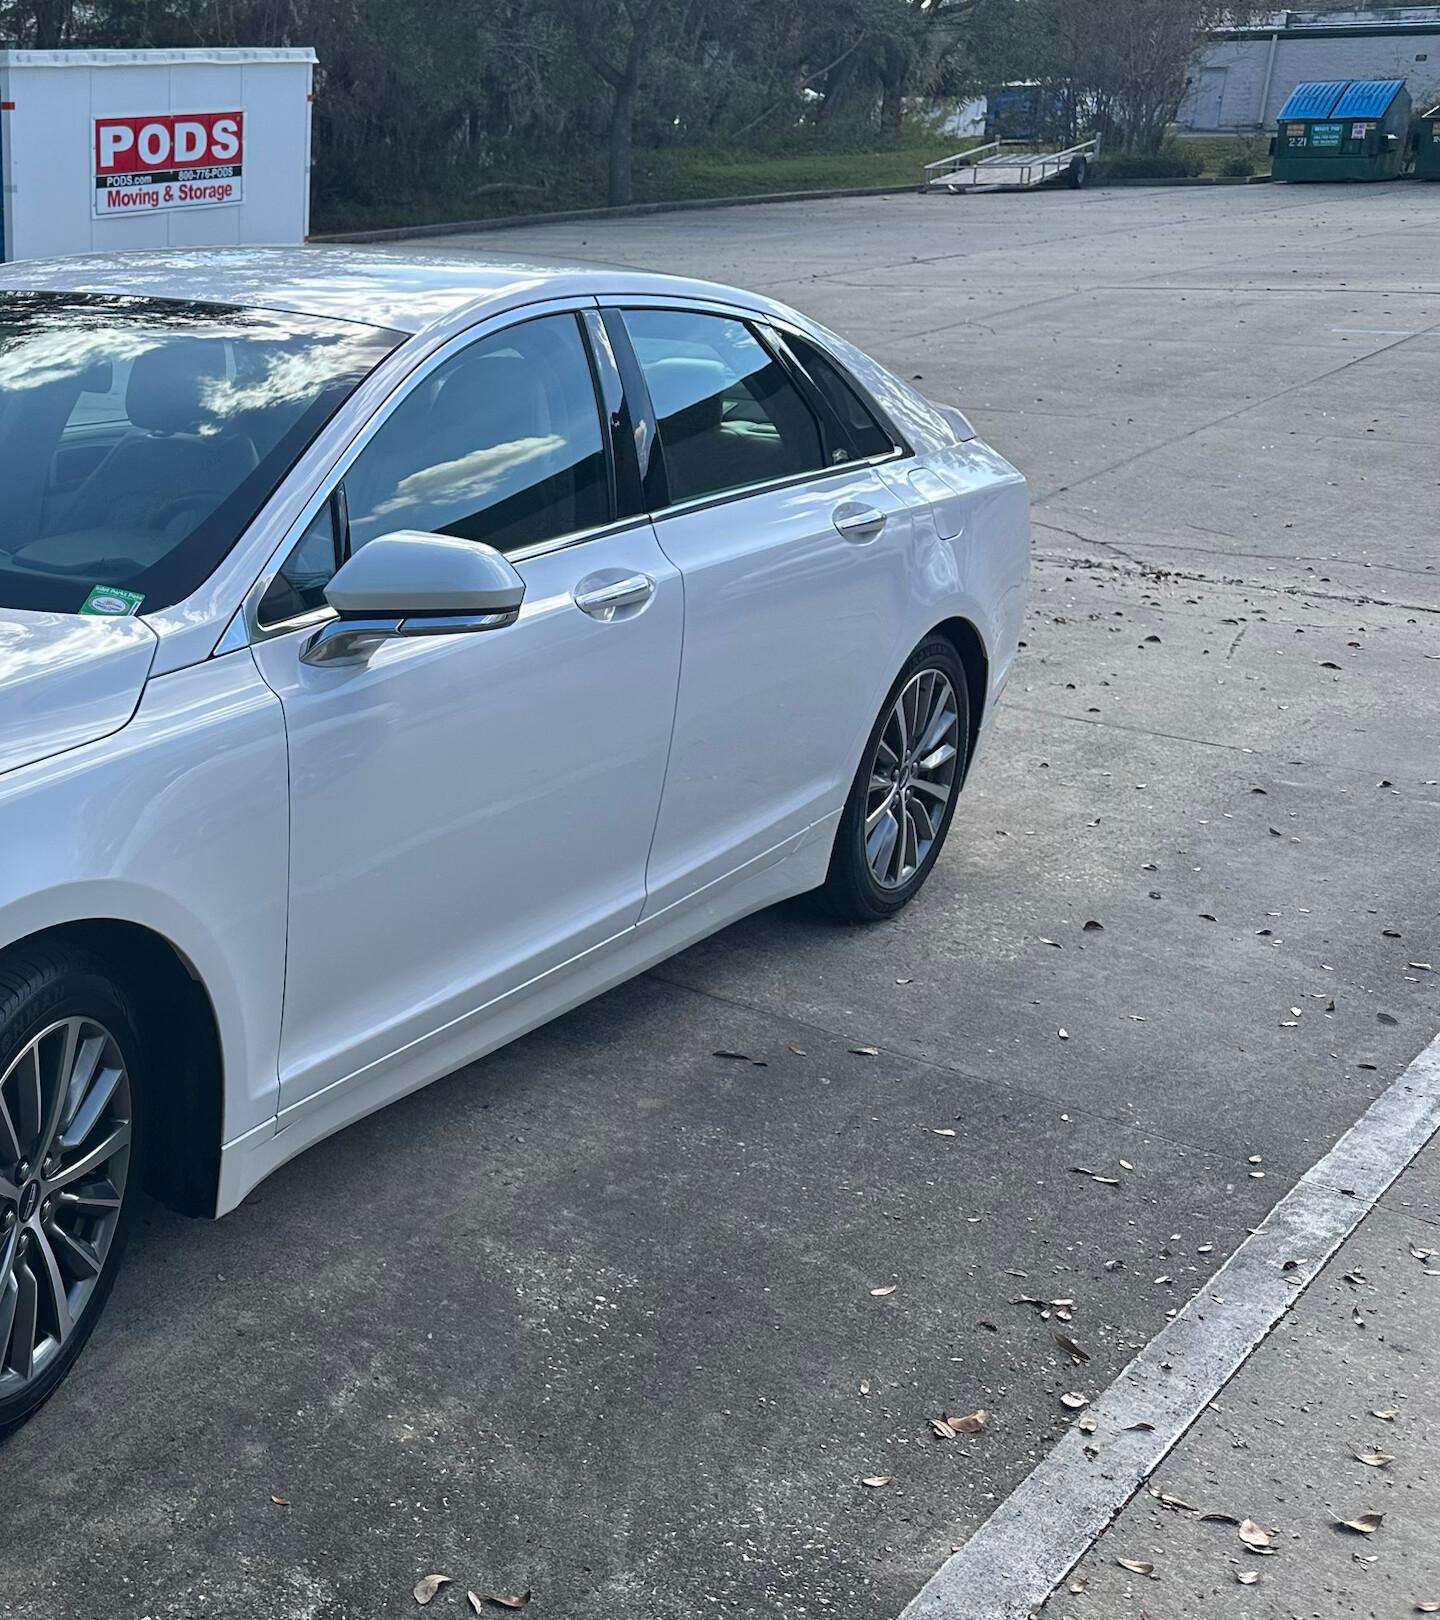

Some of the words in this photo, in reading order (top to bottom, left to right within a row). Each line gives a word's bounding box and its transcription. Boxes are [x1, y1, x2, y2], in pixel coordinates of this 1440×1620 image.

[100, 119, 239, 167] PODS
[106, 175, 152, 188] PODS.com
[107, 187, 159, 208] Moving
[163, 184, 174, 202] &
[178, 183, 233, 202] Storage
